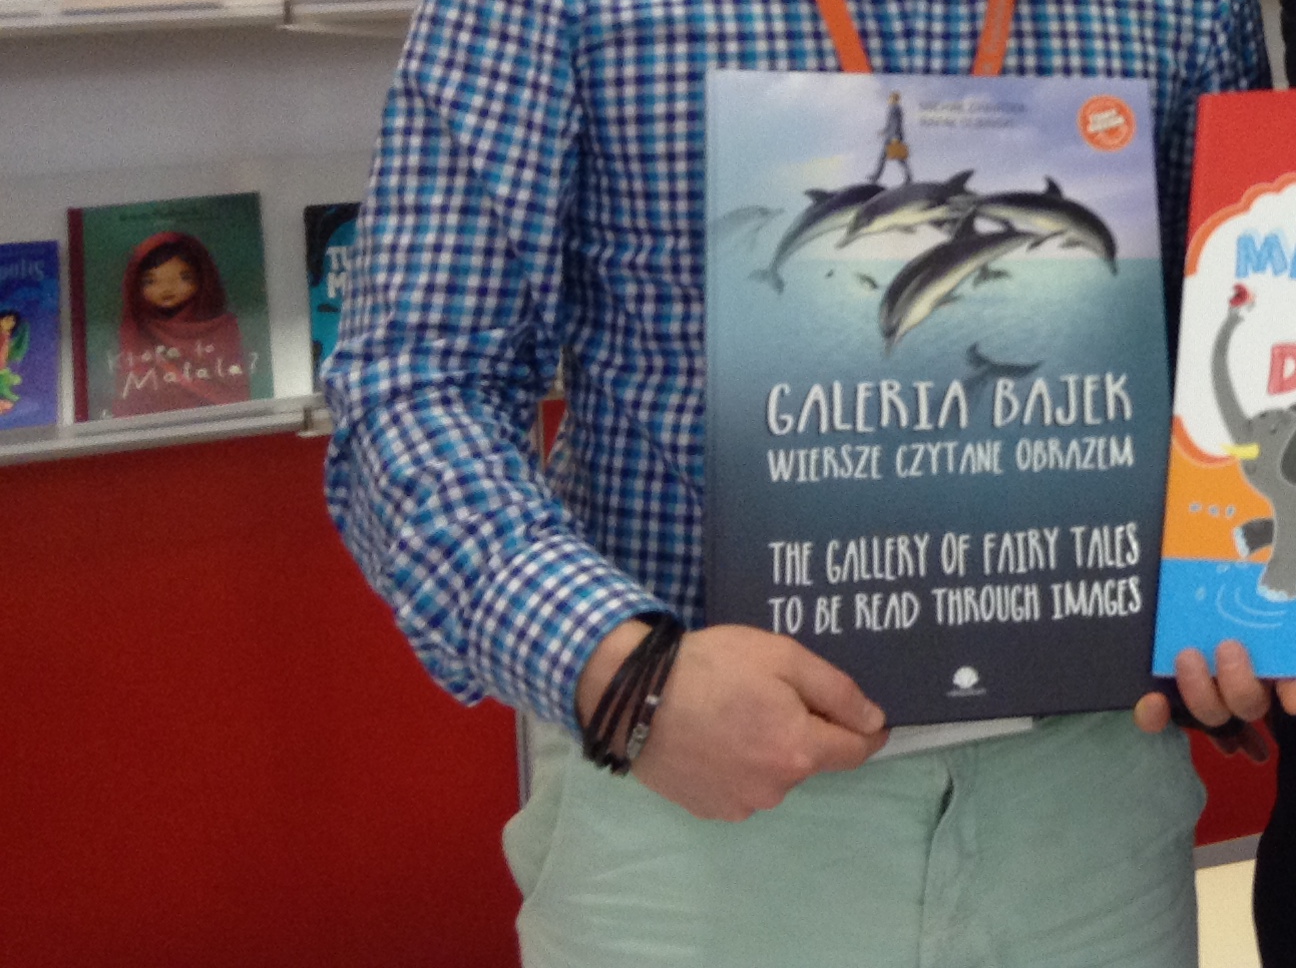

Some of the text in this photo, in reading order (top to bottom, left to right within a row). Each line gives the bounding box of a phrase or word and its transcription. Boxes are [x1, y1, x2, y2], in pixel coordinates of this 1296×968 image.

[766, 371, 1133, 436] GALERIA BAJEK
[767, 435, 1135, 482] WIERSZE CZYTANE OBRAZEM
[769, 521, 1141, 586] THE GALLERY OF FAIRY TALES
[769, 575, 1143, 635] TO BE READ THROUGH IMAGES
